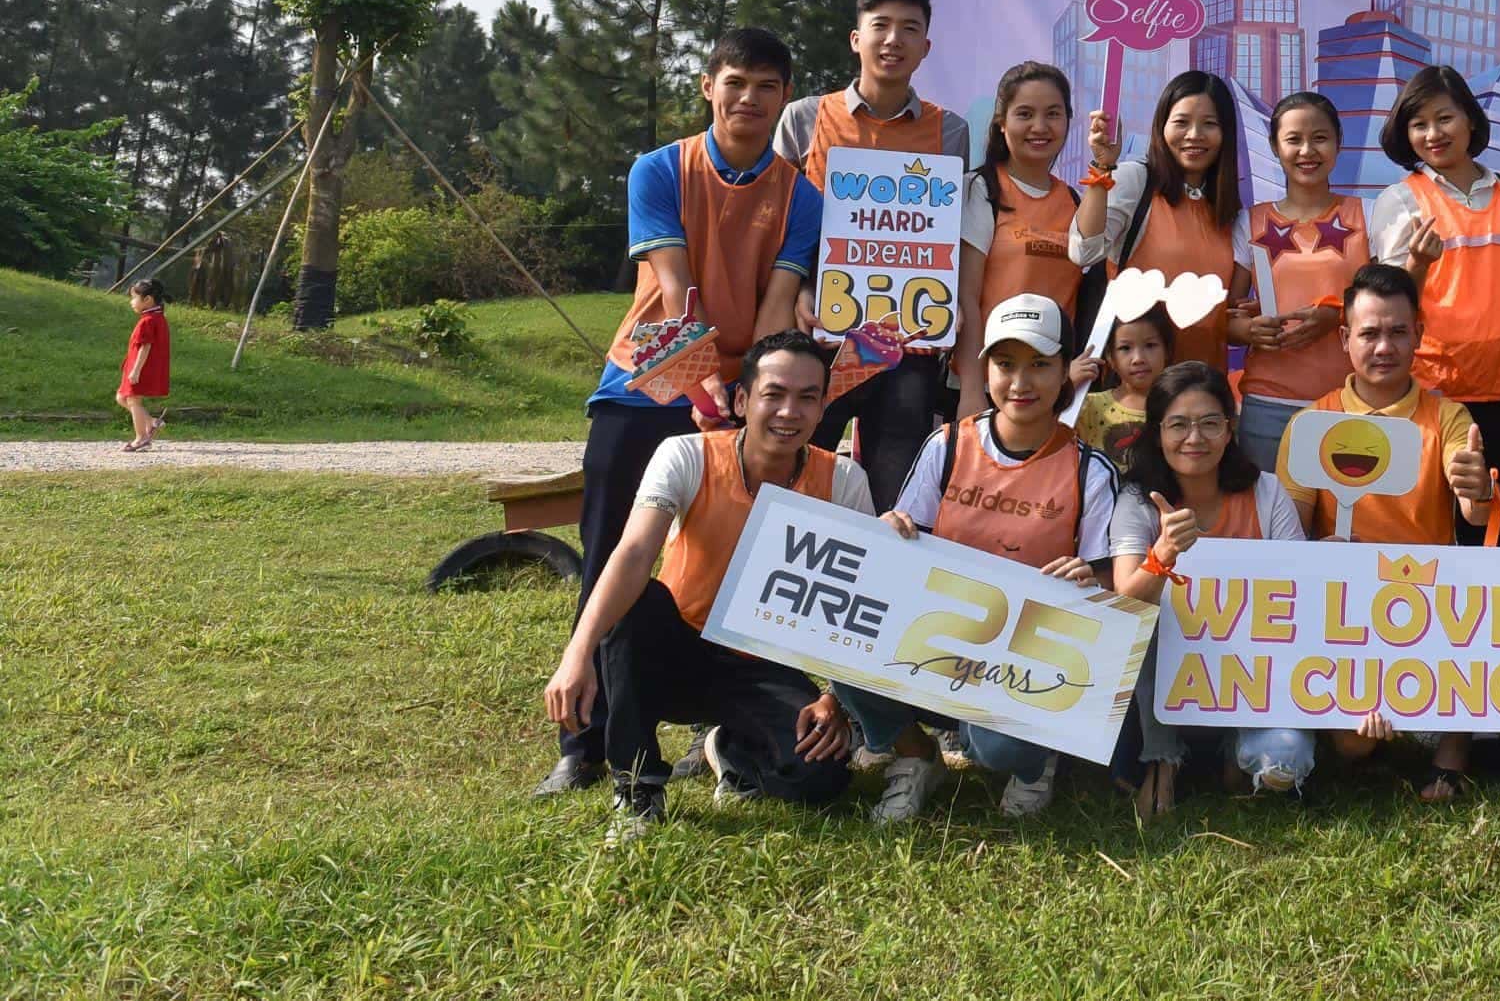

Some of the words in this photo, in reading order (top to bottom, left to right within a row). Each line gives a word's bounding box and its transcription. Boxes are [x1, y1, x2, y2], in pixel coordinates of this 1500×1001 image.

[830, 171, 958, 208] WORK
[858, 208, 927, 233] HARD
[944, 484, 1033, 517] adidas
[784, 524, 867, 584] WE
[752, 607, 798, 630] 1994
[828, 630, 876, 654] 2019
[759, 569, 890, 640] ARE
[1169, 577, 1297, 644] WE
[893, 566, 1103, 713] 25
[1164, 652, 1273, 713] AN
